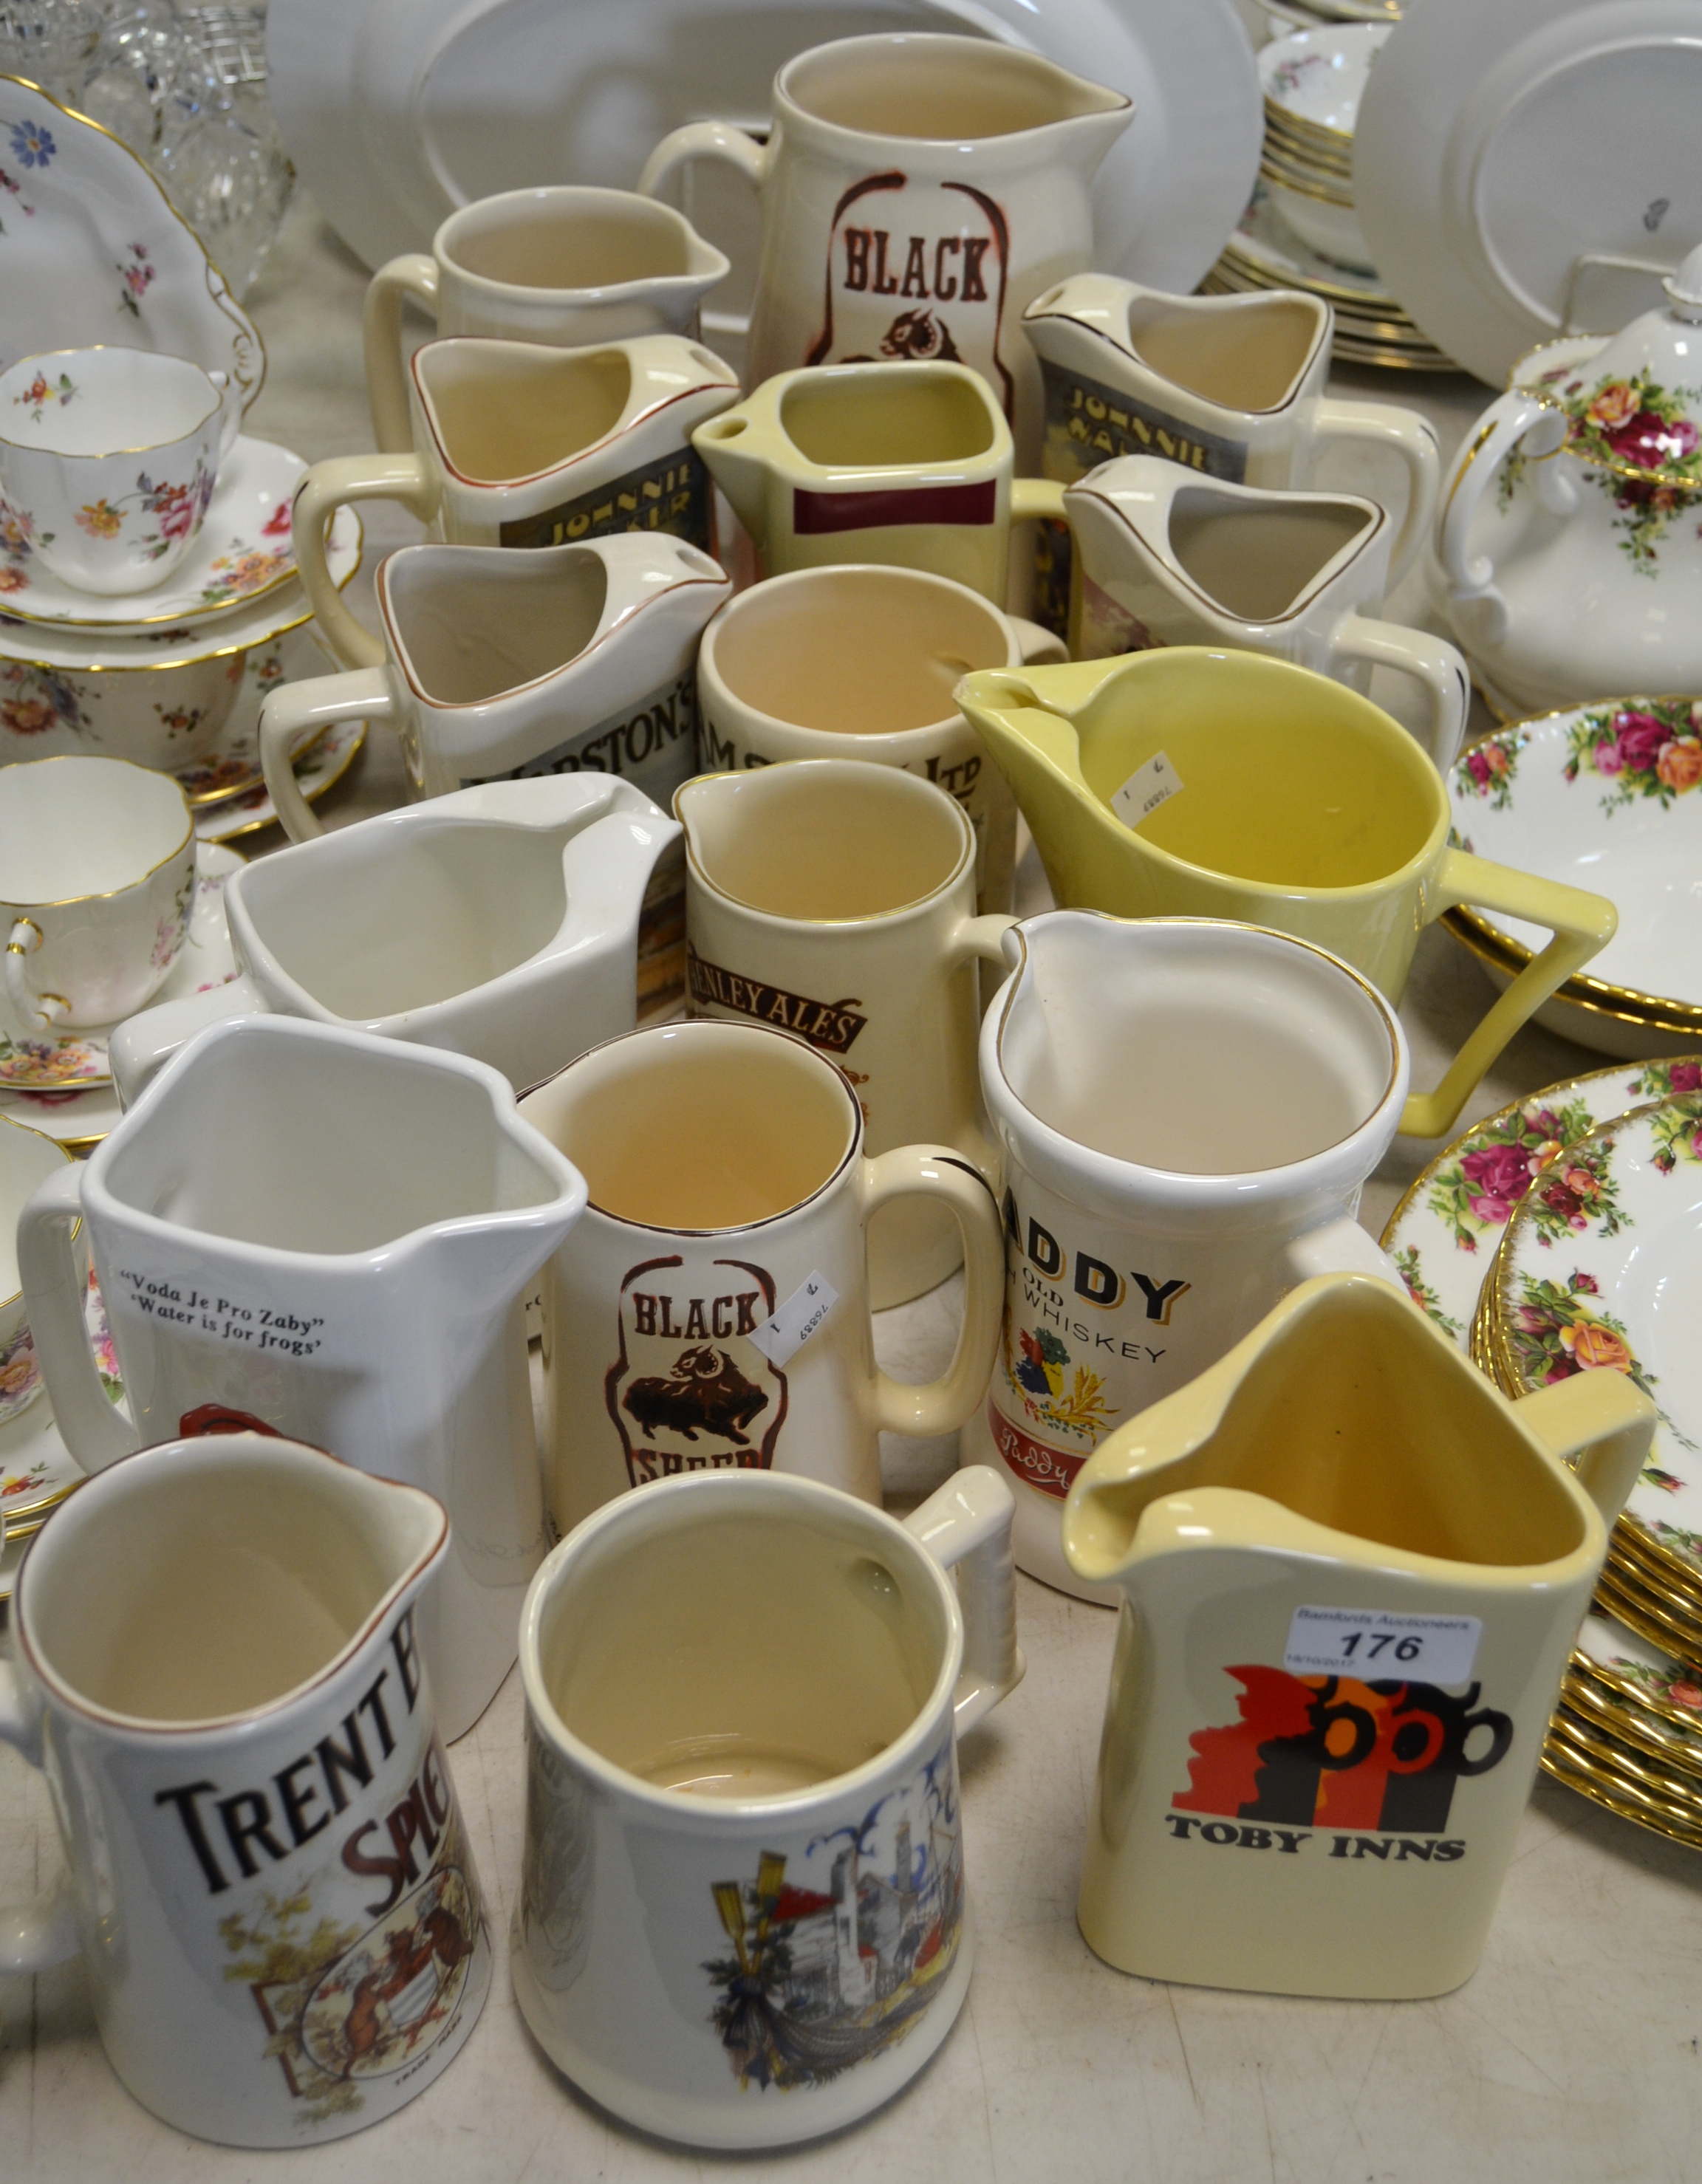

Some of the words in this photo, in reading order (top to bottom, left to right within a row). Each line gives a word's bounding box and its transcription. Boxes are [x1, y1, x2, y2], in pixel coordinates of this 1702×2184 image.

[844, 227, 990, 301] BLACK
[1067, 415, 1130, 459] WAL
[766, 993, 857, 1044] ALES
[188, 1291, 210, 1310] Je
[216, 1298, 252, 1321] Pro
[1022, 1266, 1064, 1308] OLD
[202, 1314, 217, 1331] is
[222, 1321, 254, 1341] for
[633, 1291, 760, 1340] BLACK
[800, 1304, 829, 1341] 76889
[1023, 1282, 1166, 1363] WHISKEY
[999, 1427, 1071, 1492] Paddy
[1296, 1608, 1373, 1626] Bamfords
[1376, 1613, 1470, 1631] Auctioneers
[1341, 1631, 1424, 1662] 176
[154, 1668, 397, 1895] TRENT
[1164, 1814, 1313, 1855] TOBY
[1328, 1835, 1466, 1862] INNS
